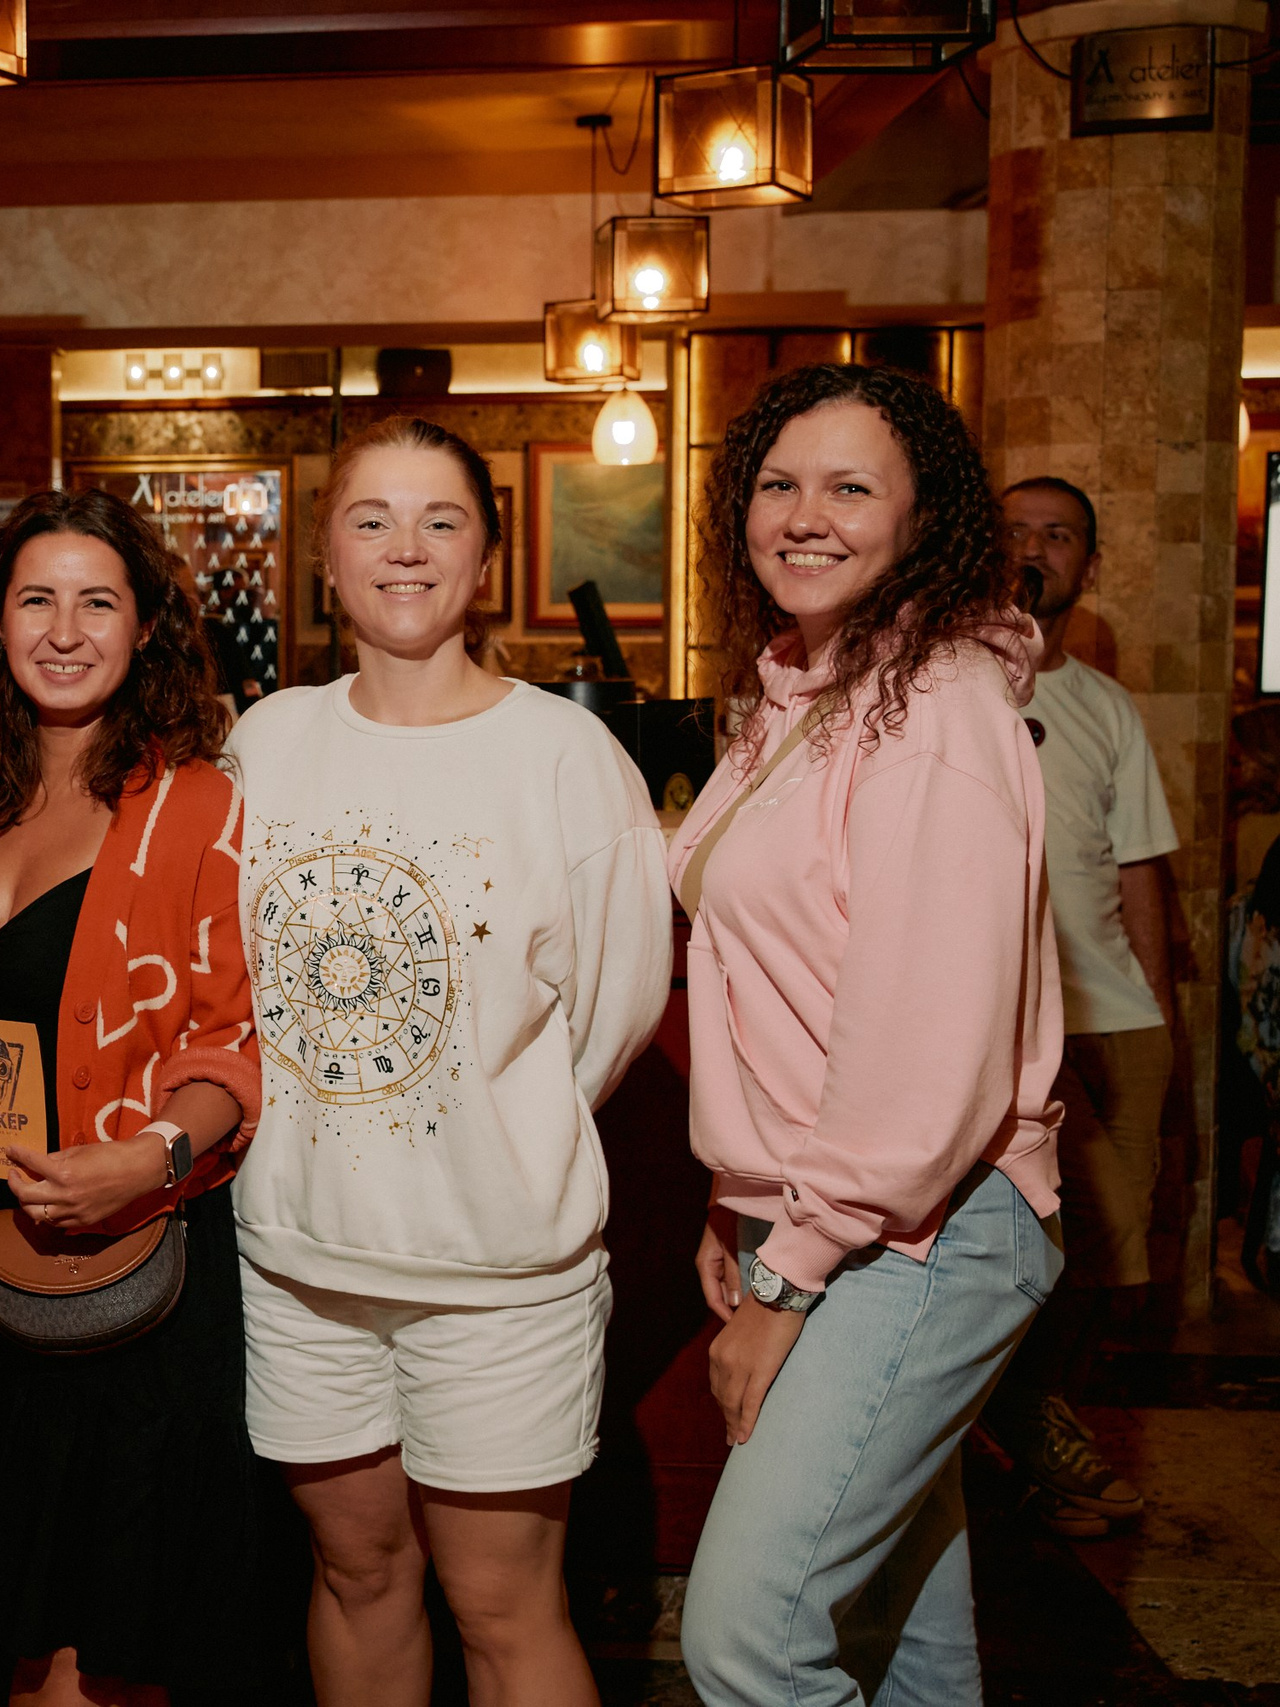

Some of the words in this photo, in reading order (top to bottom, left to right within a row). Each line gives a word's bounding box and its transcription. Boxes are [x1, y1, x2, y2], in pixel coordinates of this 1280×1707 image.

[1129, 43, 1204, 83] atelier
[288, 852, 318, 868] Pisces
[407, 862, 428, 887] Taurus
[445, 979, 459, 1014] Cancer
[382, 1082, 407, 1096] Virgo
